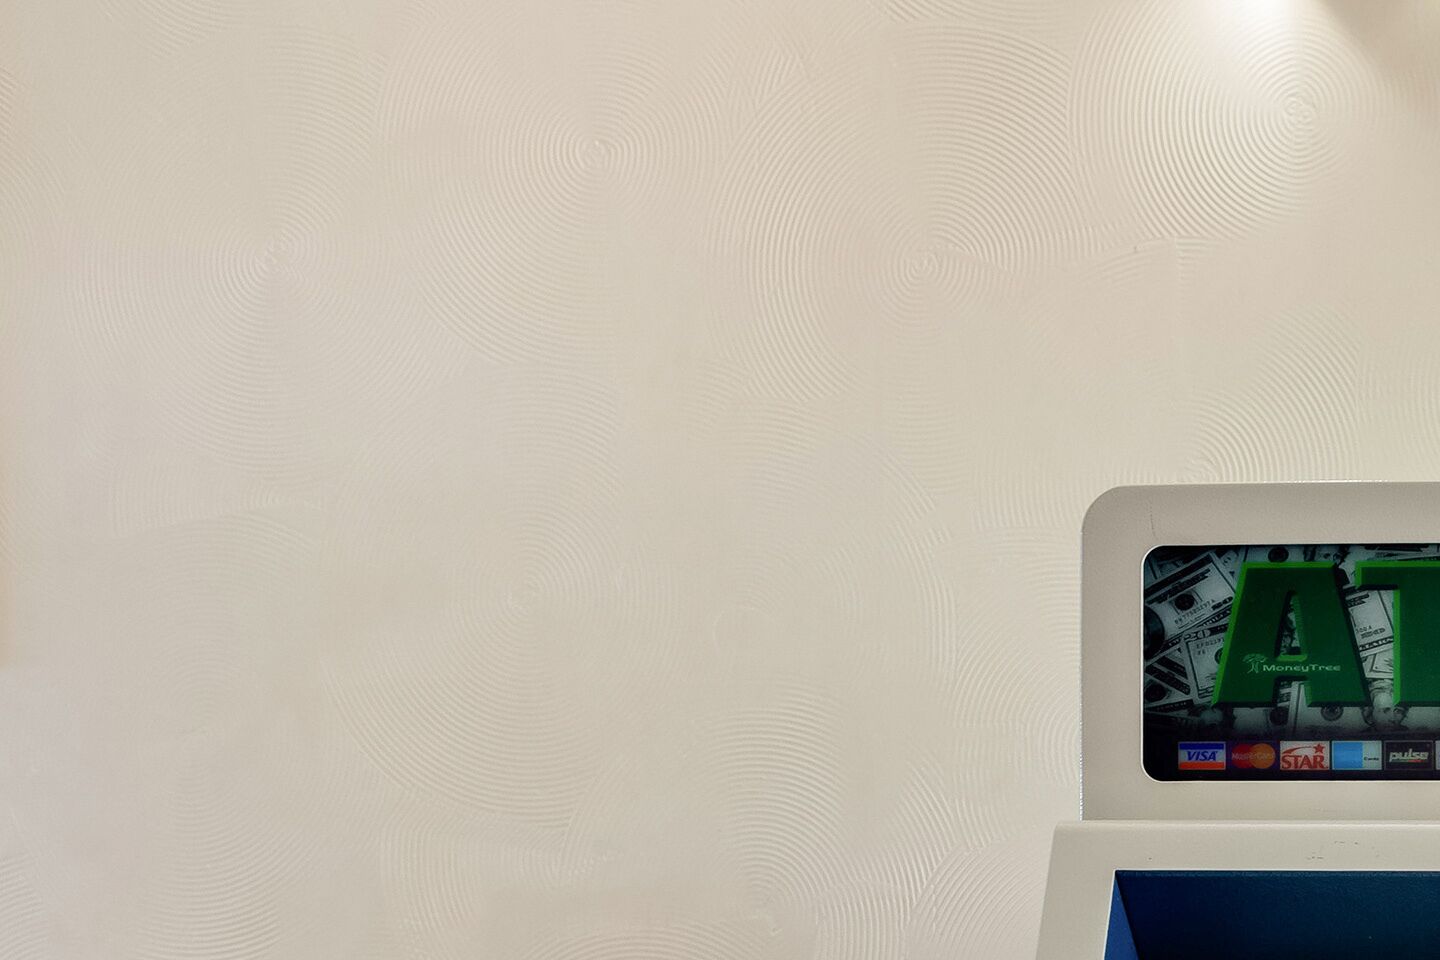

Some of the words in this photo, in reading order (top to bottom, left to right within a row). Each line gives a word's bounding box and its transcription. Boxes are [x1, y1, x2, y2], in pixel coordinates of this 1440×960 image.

[1262, 662, 1341, 673] MoneyTree
[1186, 750, 1217, 761] VISA
[1389, 749, 1429, 762] pulse
[1281, 755, 1325, 769] STAR
